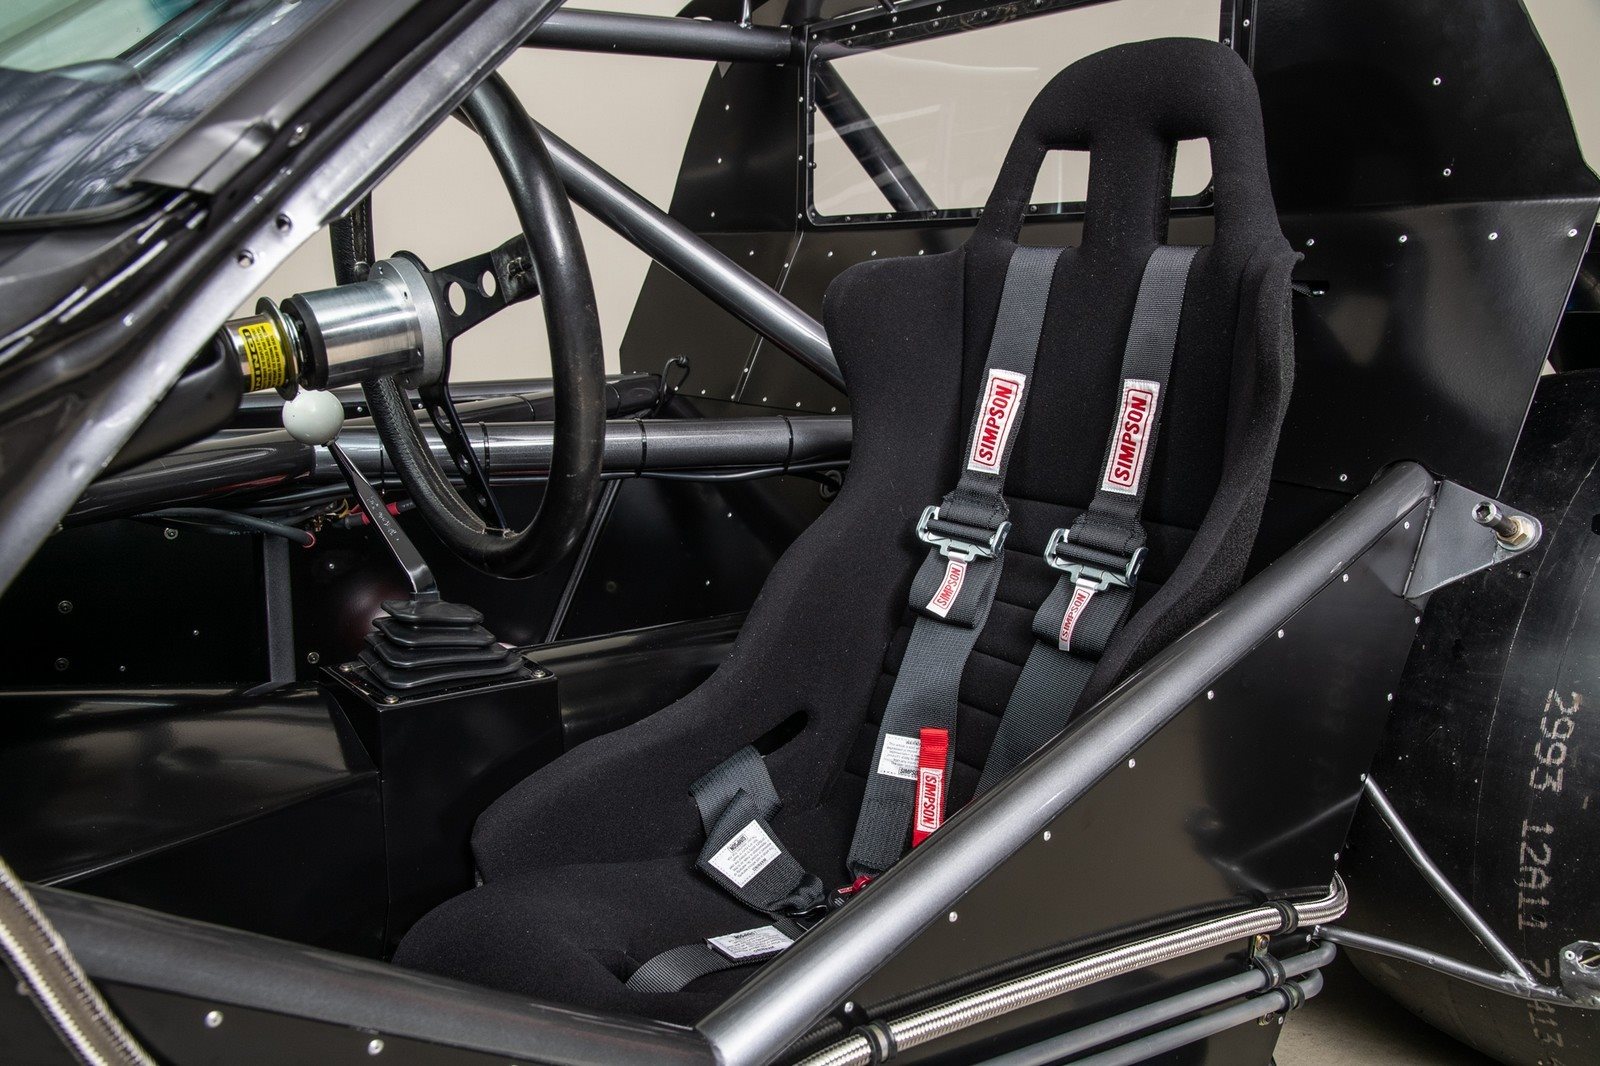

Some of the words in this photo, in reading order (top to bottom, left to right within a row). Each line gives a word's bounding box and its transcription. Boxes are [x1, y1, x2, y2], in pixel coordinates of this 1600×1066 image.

[979, 385, 1012, 461] SIMPSON
[1114, 396, 1147, 481] SIMPSON
[937, 567, 961, 606] SIMPSON
[1061, 593, 1086, 637] SIMPSON
[1529, 689, 1582, 792] 2993
[923, 775, 936, 825] SIMPSON
